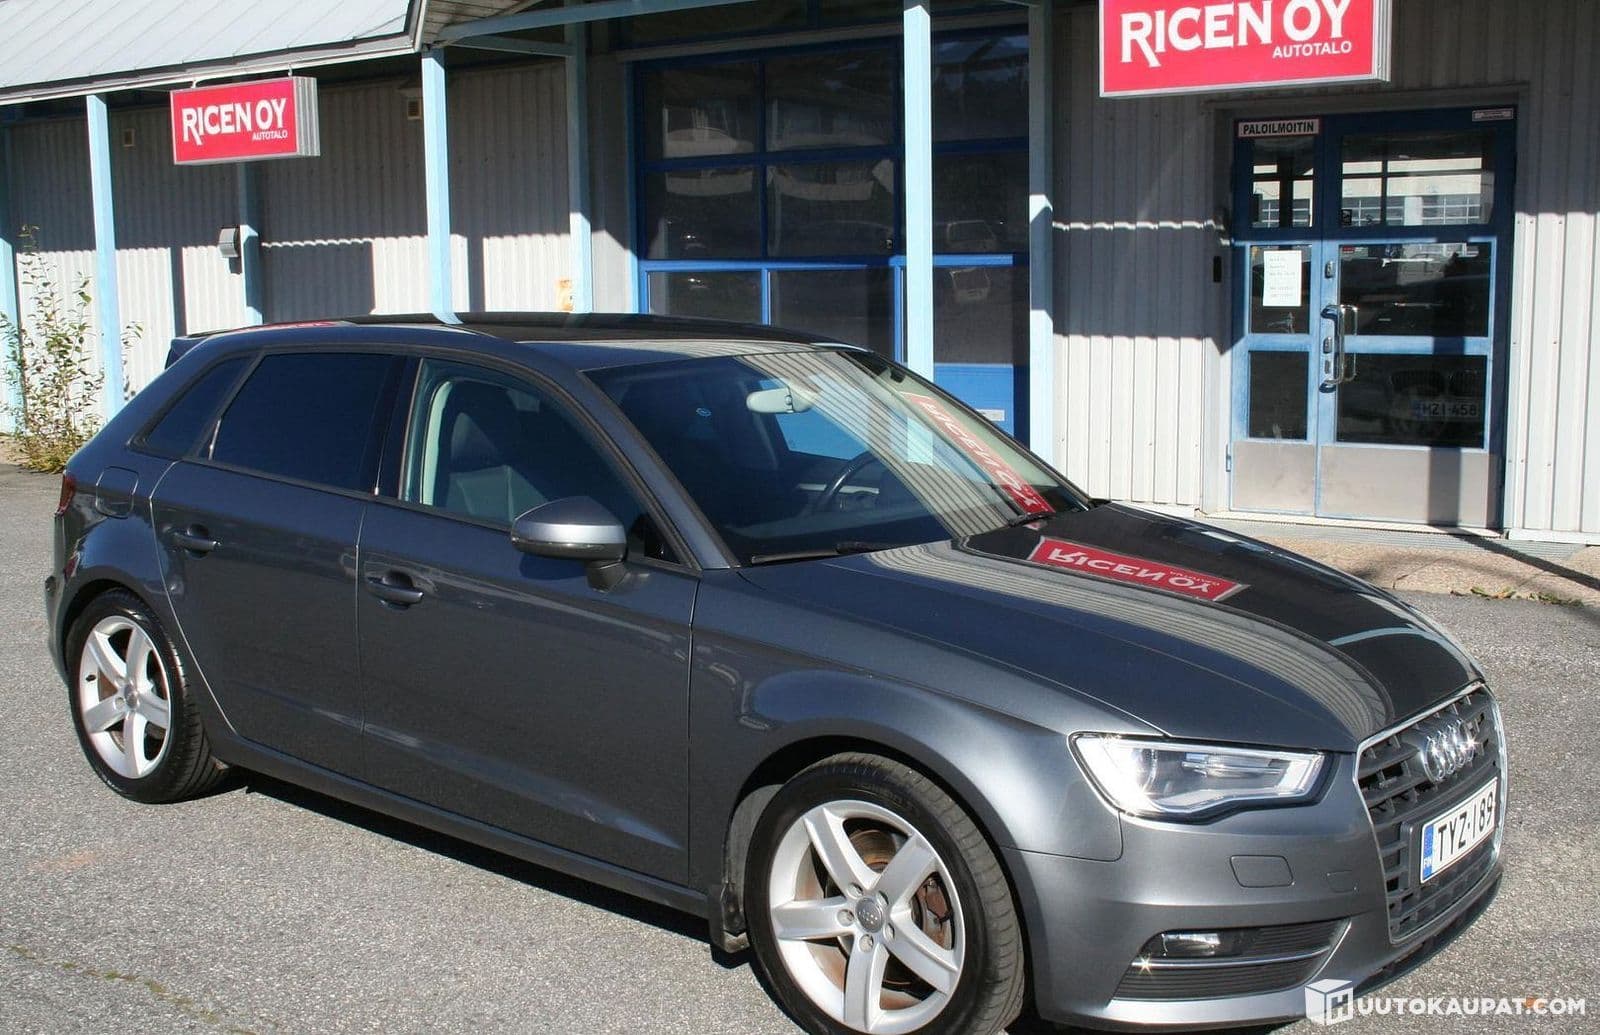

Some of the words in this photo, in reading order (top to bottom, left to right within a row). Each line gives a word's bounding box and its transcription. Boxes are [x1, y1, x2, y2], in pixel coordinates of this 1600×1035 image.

[1120, 1, 1272, 67] RICEN
[1283, 0, 1351, 41] OY
[1272, 40, 1353, 59] AUTOTALO
[182, 102, 252, 146] RICEN
[255, 97, 287, 129] OY
[252, 130, 288, 141] AUTOTALO
[1242, 122, 1315, 136] PALOILMOITIN
[1438, 791, 1493, 862] TYZ-189
